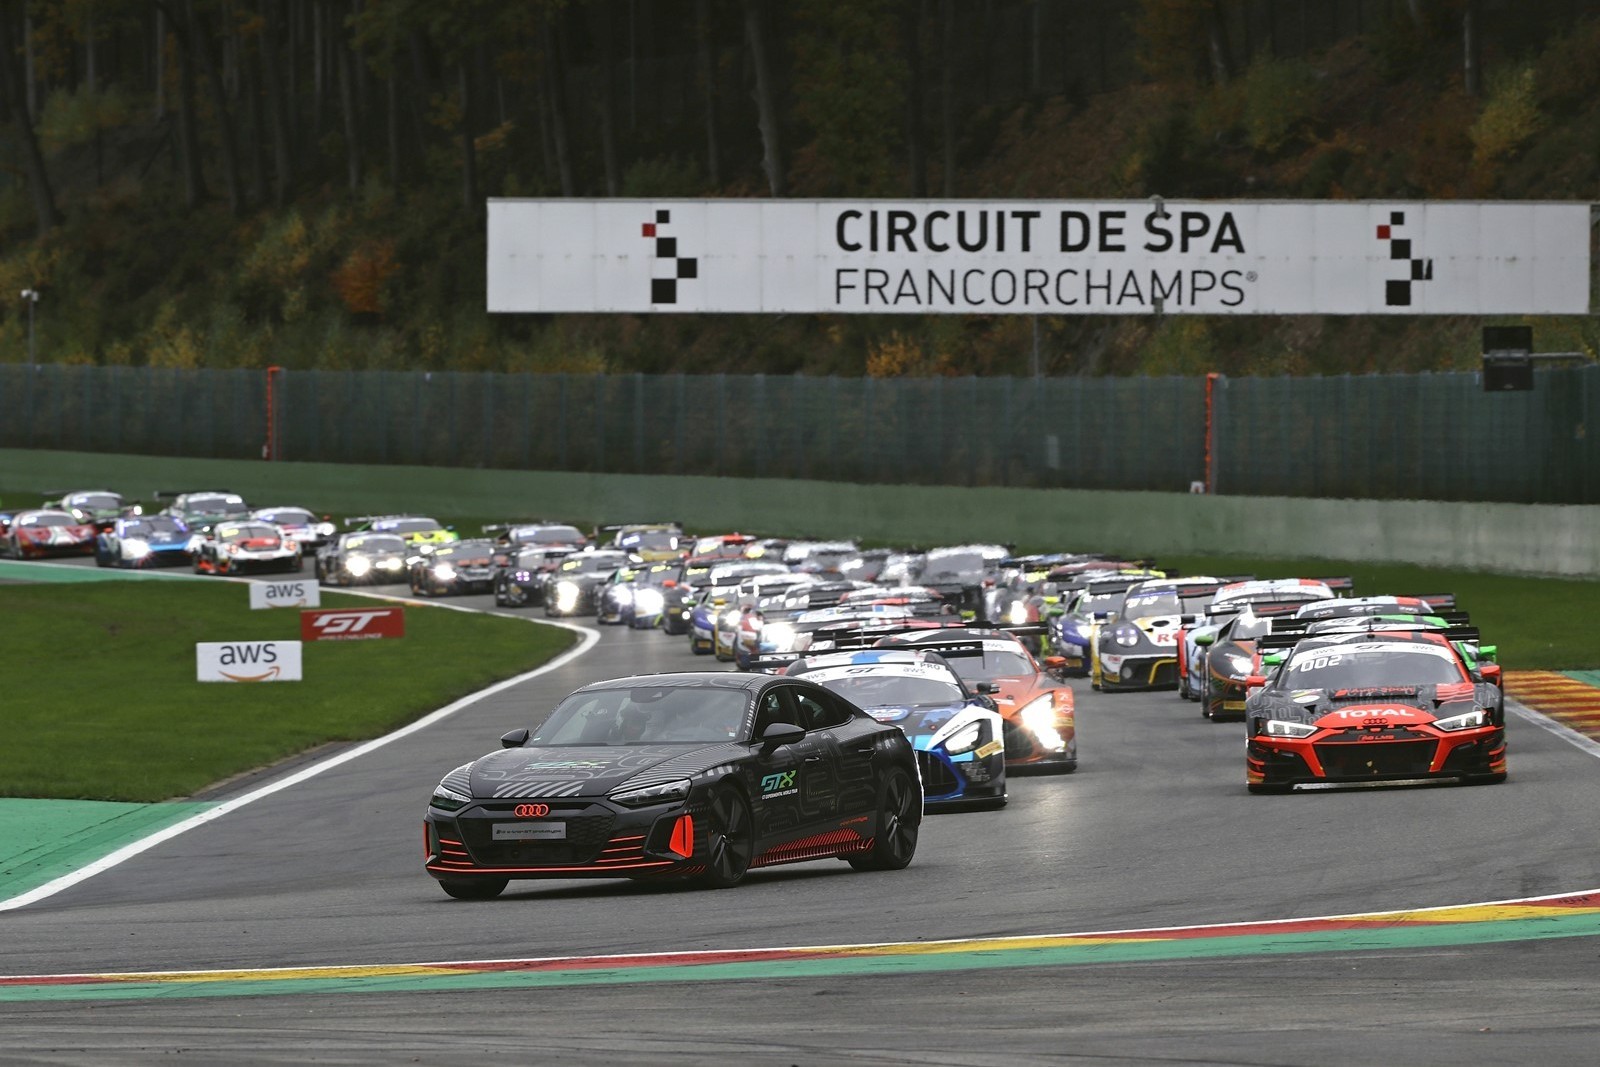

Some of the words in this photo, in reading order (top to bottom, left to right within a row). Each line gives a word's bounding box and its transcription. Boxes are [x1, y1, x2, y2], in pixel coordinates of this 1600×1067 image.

[836, 210, 1041, 253] CIRCUIT
[1060, 211, 1126, 253] DE
[1144, 211, 1246, 254] SPA
[266, 582, 305, 599] aws
[312, 610, 392, 634] GT
[219, 643, 278, 665] aws
[903, 666, 926, 674] aws
[920, 662, 941, 671] PRO
[1300, 655, 1343, 672] 002
[1335, 708, 1416, 719] TOTAL
[760, 769, 797, 792] GTX
